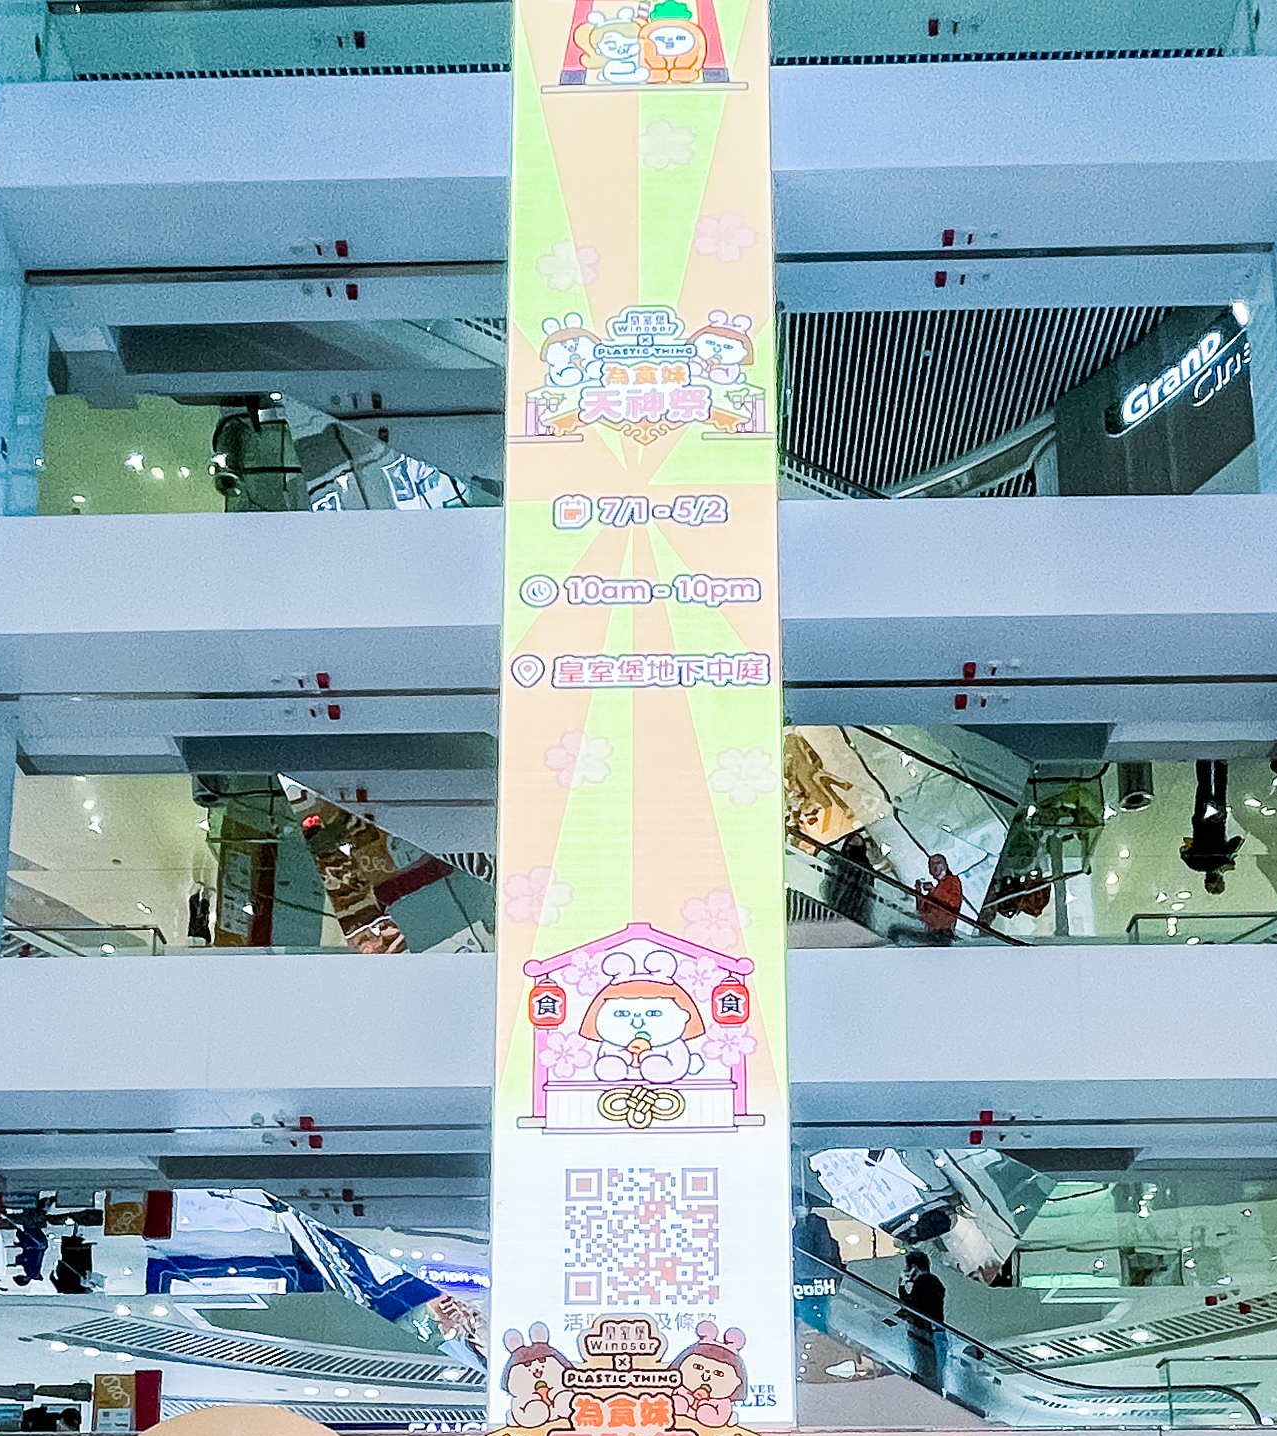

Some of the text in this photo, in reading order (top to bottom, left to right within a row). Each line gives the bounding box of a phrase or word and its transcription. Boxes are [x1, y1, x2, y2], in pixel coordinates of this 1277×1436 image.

[583, 388, 708, 420] 天神祭
[600, 499, 645, 524] 7/1
[677, 499, 724, 522] 5/2
[569, 579, 647, 600] 10am
[677, 578, 755, 603] 10pm
[557, 657, 765, 684] 皇室堡地下中庭
[535, 993, 740, 1015] 食 食
[589, 1340, 655, 1351] Windsor
[567, 1373, 678, 1384] PLASTIC THING
